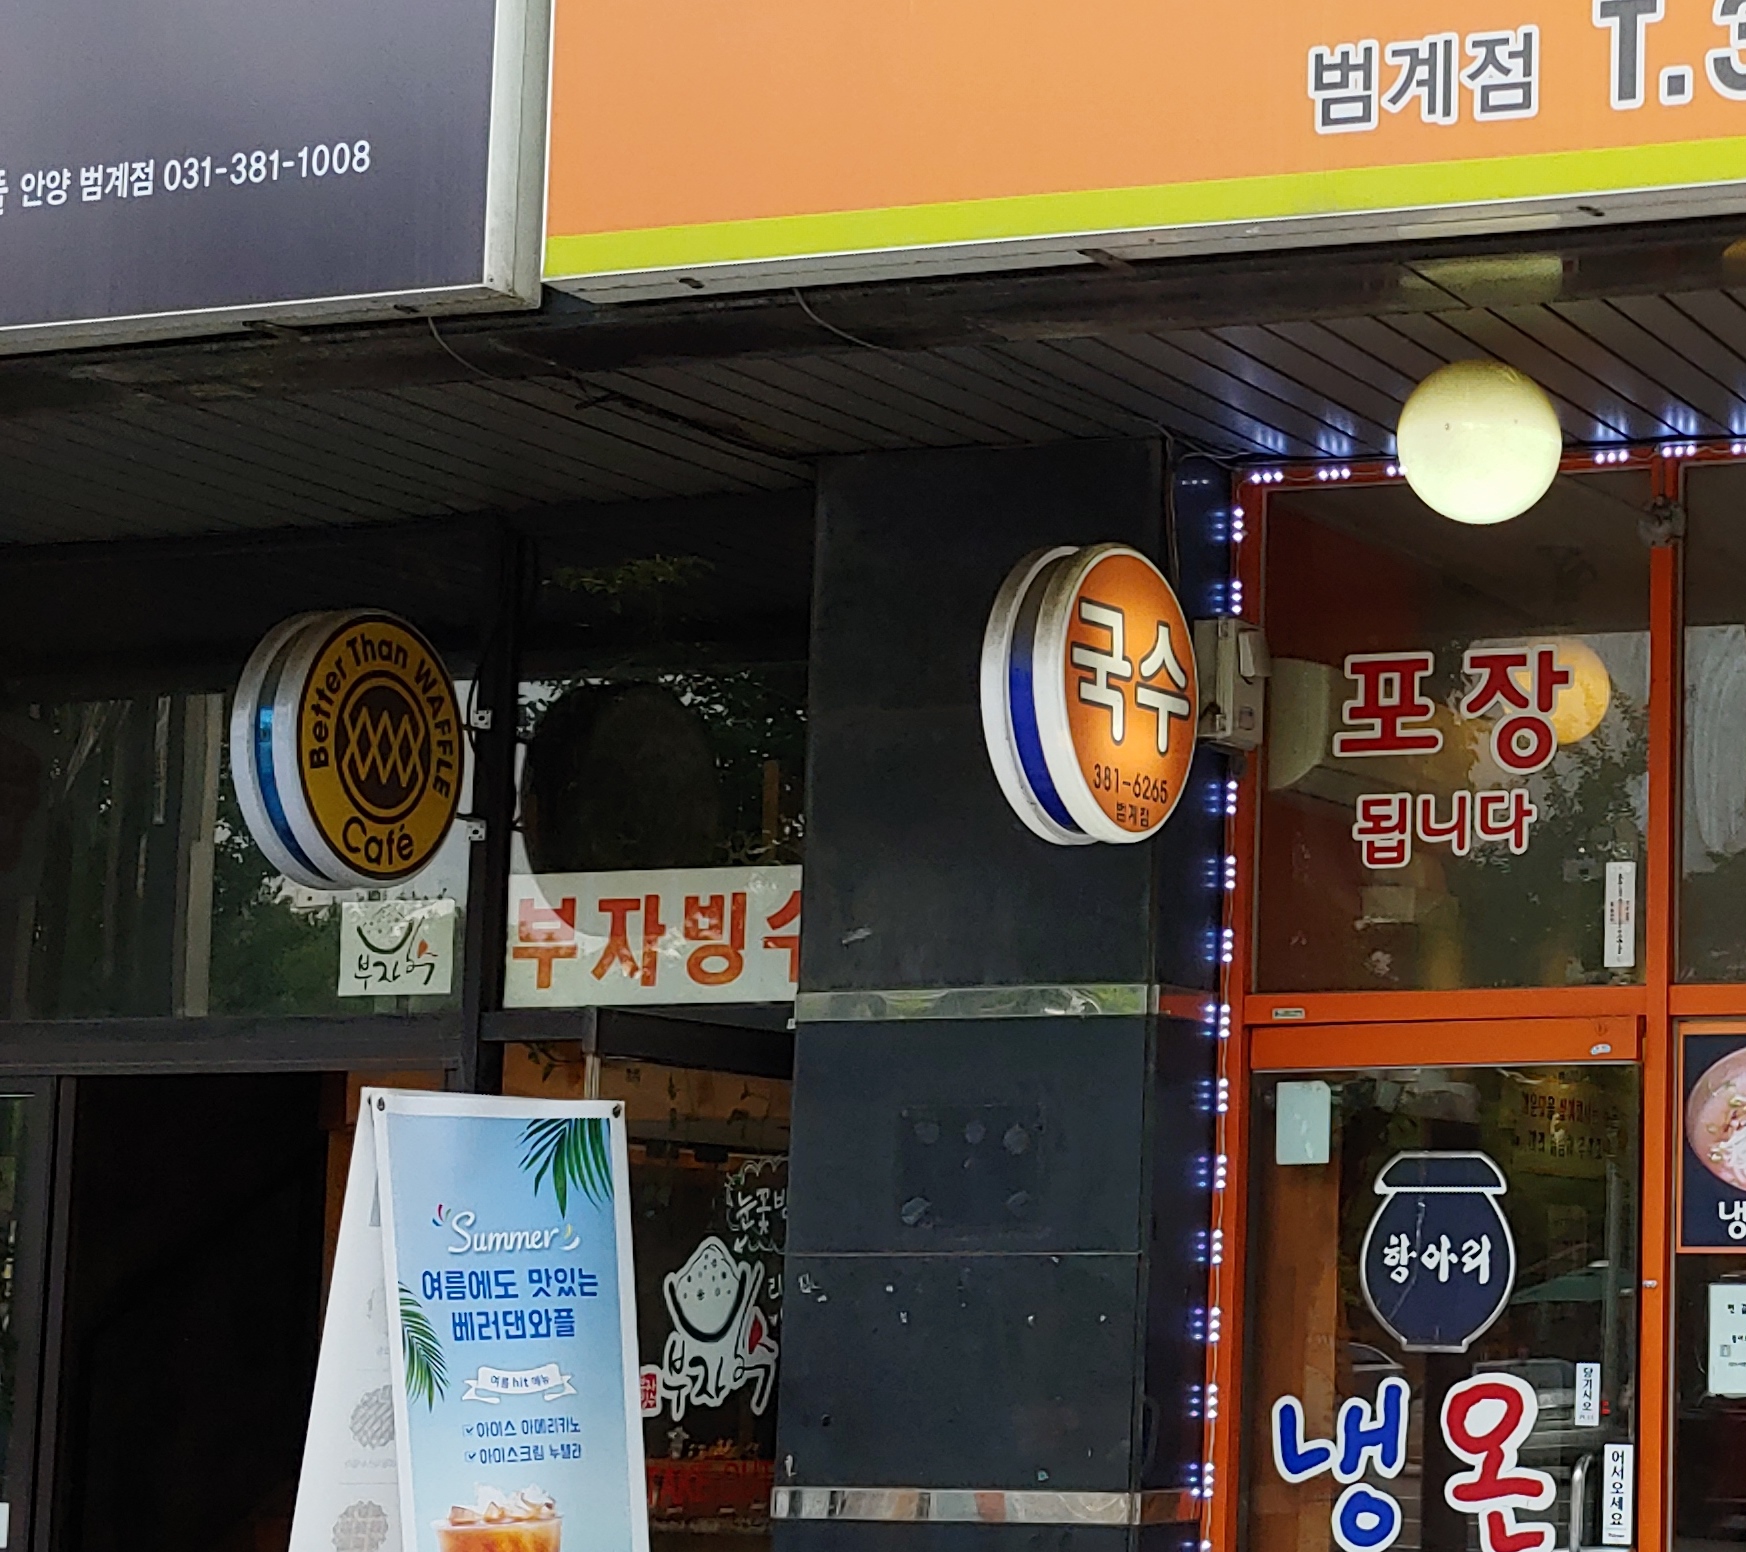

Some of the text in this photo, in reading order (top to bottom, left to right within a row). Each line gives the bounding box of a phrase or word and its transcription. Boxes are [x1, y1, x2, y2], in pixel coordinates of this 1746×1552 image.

[1308, 24, 1540, 134] 범계점
[20, 168, 71, 207] 안양
[80, 159, 155, 202] 범계점
[163, 140, 371, 191] 031-381-1008
[1069, 596, 1191, 756] 국수
[309, 633, 453, 799] Better Than WAFFLE
[1332, 644, 1577, 775] 포장
[1093, 763, 1168, 804] 381-6265
[1116, 800, 1149, 828] 범계점
[1353, 789, 1537, 870] 됩니다
[342, 815, 414, 866] Café
[448, 1211, 559, 1253] Summer
[422, 1267, 599, 1300] 여름에도 맛있는
[1383, 1234, 1491, 1285] 항아리
[451, 1308, 575, 1342] 베러댄와플
[512, 1376, 529, 1388] hit
[476, 1420, 517, 1438] 아이스
[479, 1445, 545, 1464] 아이스크림
[1610, 1450, 1625, 1525] 어서오세요
